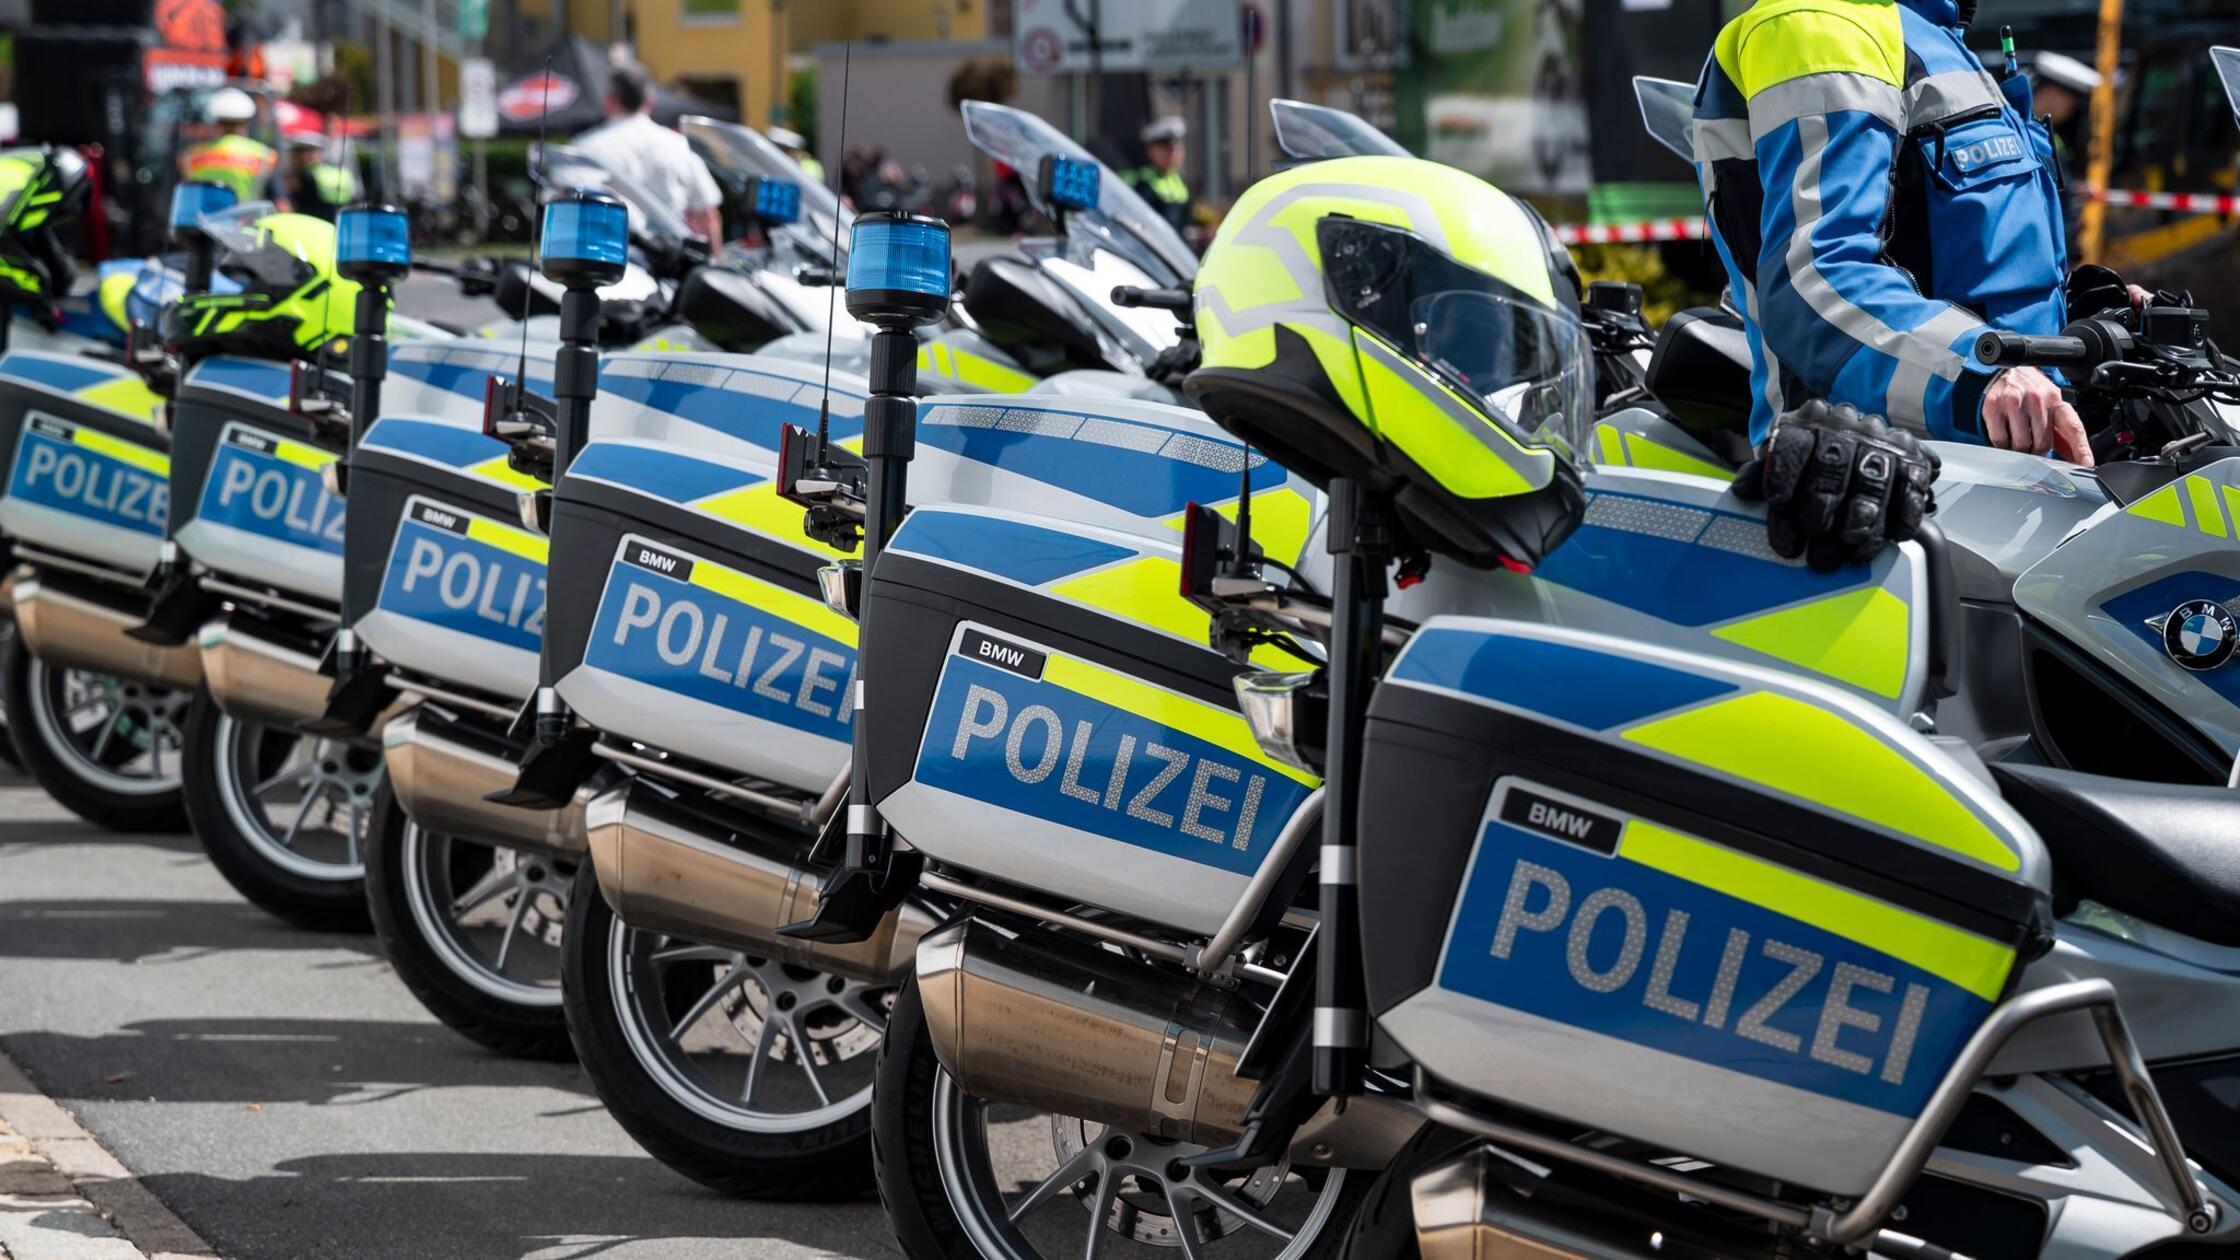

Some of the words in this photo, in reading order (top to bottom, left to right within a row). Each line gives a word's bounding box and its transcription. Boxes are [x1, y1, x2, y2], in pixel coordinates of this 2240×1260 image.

[1954, 134, 2022, 168] POLIZEI
[26, 443, 170, 527] POLIZE
[422, 508, 456, 528] BMW
[639, 550, 676, 572] BMW
[2179, 603, 2233, 631] BMW
[613, 582, 858, 724] POLIZEI
[979, 640, 1024, 667] BMW
[951, 684, 1266, 851] POLIZEI
[1528, 801, 1594, 839] BMW
[1490, 859, 1930, 1085] POLIZEI
[907, 1055, 954, 1232] MICHELIN
